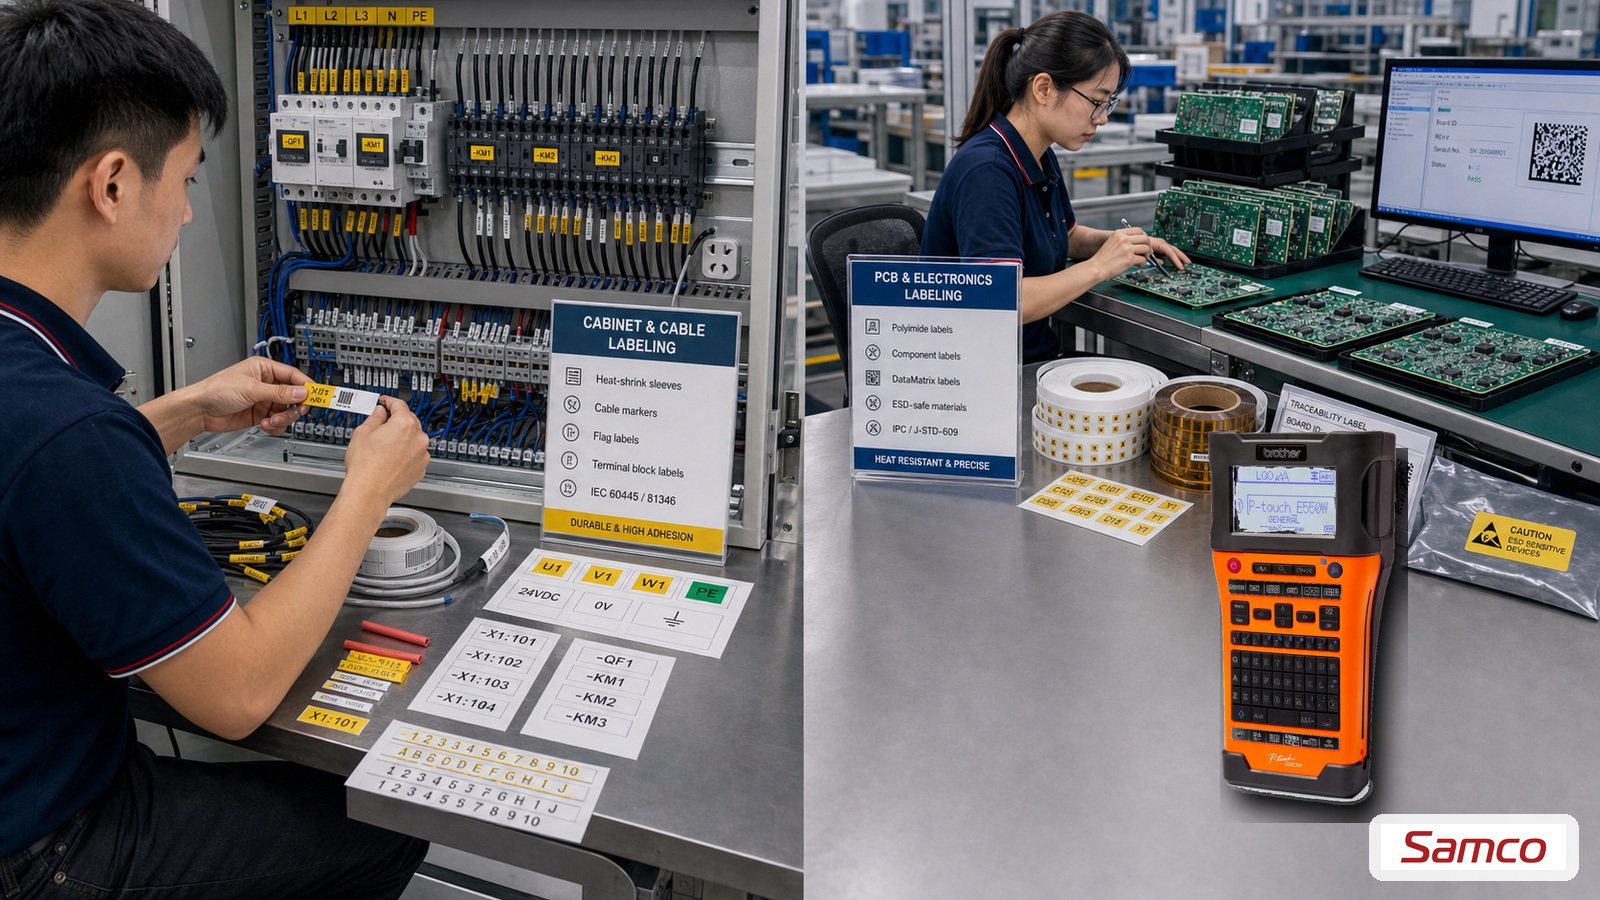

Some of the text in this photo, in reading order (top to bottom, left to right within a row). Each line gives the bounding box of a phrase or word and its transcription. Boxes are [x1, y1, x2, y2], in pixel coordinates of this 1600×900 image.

[296, 11, 307, 21] L1
[324, 11, 337, 21] L2
[355, 11, 368, 21] L3
[388, 11, 396, 21] N
[413, 11, 427, 21] PE
[473, 149, 491, 157] -KM1
[537, 151, 555, 160] -KM2
[598, 154, 617, 162] -KM3
[875, 272, 992, 285] PCB & ELECTRONICS
[905, 289, 962, 301] LABELING
[583, 316, 705, 336] CABINET & CABLE
[892, 324, 953, 334] Polyimide labels
[609, 337, 676, 354] LABELING
[892, 349, 961, 360] Component labels
[596, 374, 682, 390] Heat-shrink sleeves
[892, 375, 960, 386] DataMatrix labels
[595, 403, 657, 417] Cable markers
[892, 400, 967, 411] ESD-safe materials
[1291, 400, 1367, 431] TRACEABILITY LABEL
[1286, 416, 1311, 430] BOARD
[892, 425, 958, 436] IPC / J-STD-609
[594, 432, 639, 444] Flag labels
[1263, 448, 1301, 458] brother
[592, 460, 684, 478] Terminal block labels
[875, 455, 896, 463] HEAT
[898, 456, 943, 467] RESISTANT
[954, 460, 990, 470] PRECISE
[591, 487, 676, 505] IEC 60445 / 81346
[1248, 500, 1328, 514] P-touch E550W
[1268, 516, 1300, 524] GENERAL
[571, 518, 693, 542] DURABLE & HIGH ADHESION
[1510, 526, 1552, 541] CAUTION
[1506, 545, 1540, 557] DEVICES
[1526, 540, 1566, 555] SENSITIVE
[543, 563, 562, 573] U1
[594, 571, 613, 581] V1
[642, 578, 665, 589] W1
[518, 587, 561, 602] 24VDC
[695, 587, 720, 598] PE
[480, 629, 537, 647] -X1:101
[466, 651, 523, 668] -X1:102
[597, 655, 633, 668] -QF1
[452, 672, 510, 690] -X1:103
[587, 673, 624, 687] -KM1
[437, 693, 496, 712] -X1:104
[576, 692, 617, 707] -KM2
[309, 711, 358, 729] X1:101
[566, 712, 607, 728] -KM3
[412, 732, 419, 741] 1
[423, 735, 434, 744] 2
[438, 738, 447, 747] 3
[466, 744, 475, 753] 4
[482, 747, 492, 757] 5
[498, 751, 508, 761] 6
[515, 754, 524, 764] 7
[530, 758, 540, 768] 8
[546, 762, 555, 771] 9
[562, 765, 579, 777] 10
[398, 747, 407, 756] A
[456, 760, 468, 769] D
[472, 764, 483, 773] E
[488, 767, 498, 777] F
[505, 771, 516, 781] G
[522, 775, 533, 786] H
[558, 784, 568, 793] J
[387, 766, 395, 776] 1
[401, 769, 411, 779] 2
[417, 773, 426, 782] 3
[433, 776, 442, 786] 4
[498, 792, 508, 801] G
[514, 796, 526, 806] H
[548, 804, 558, 814] J
[379, 780, 385, 789] 1
[391, 784, 401, 793] 2
[407, 787, 417, 797] 3
[423, 791, 432, 800] 4
[439, 794, 449, 804] 5
[473, 802, 484, 812] 7
[490, 806, 499, 816] 8
[507, 811, 516, 820] 9
[524, 815, 540, 827] 10
